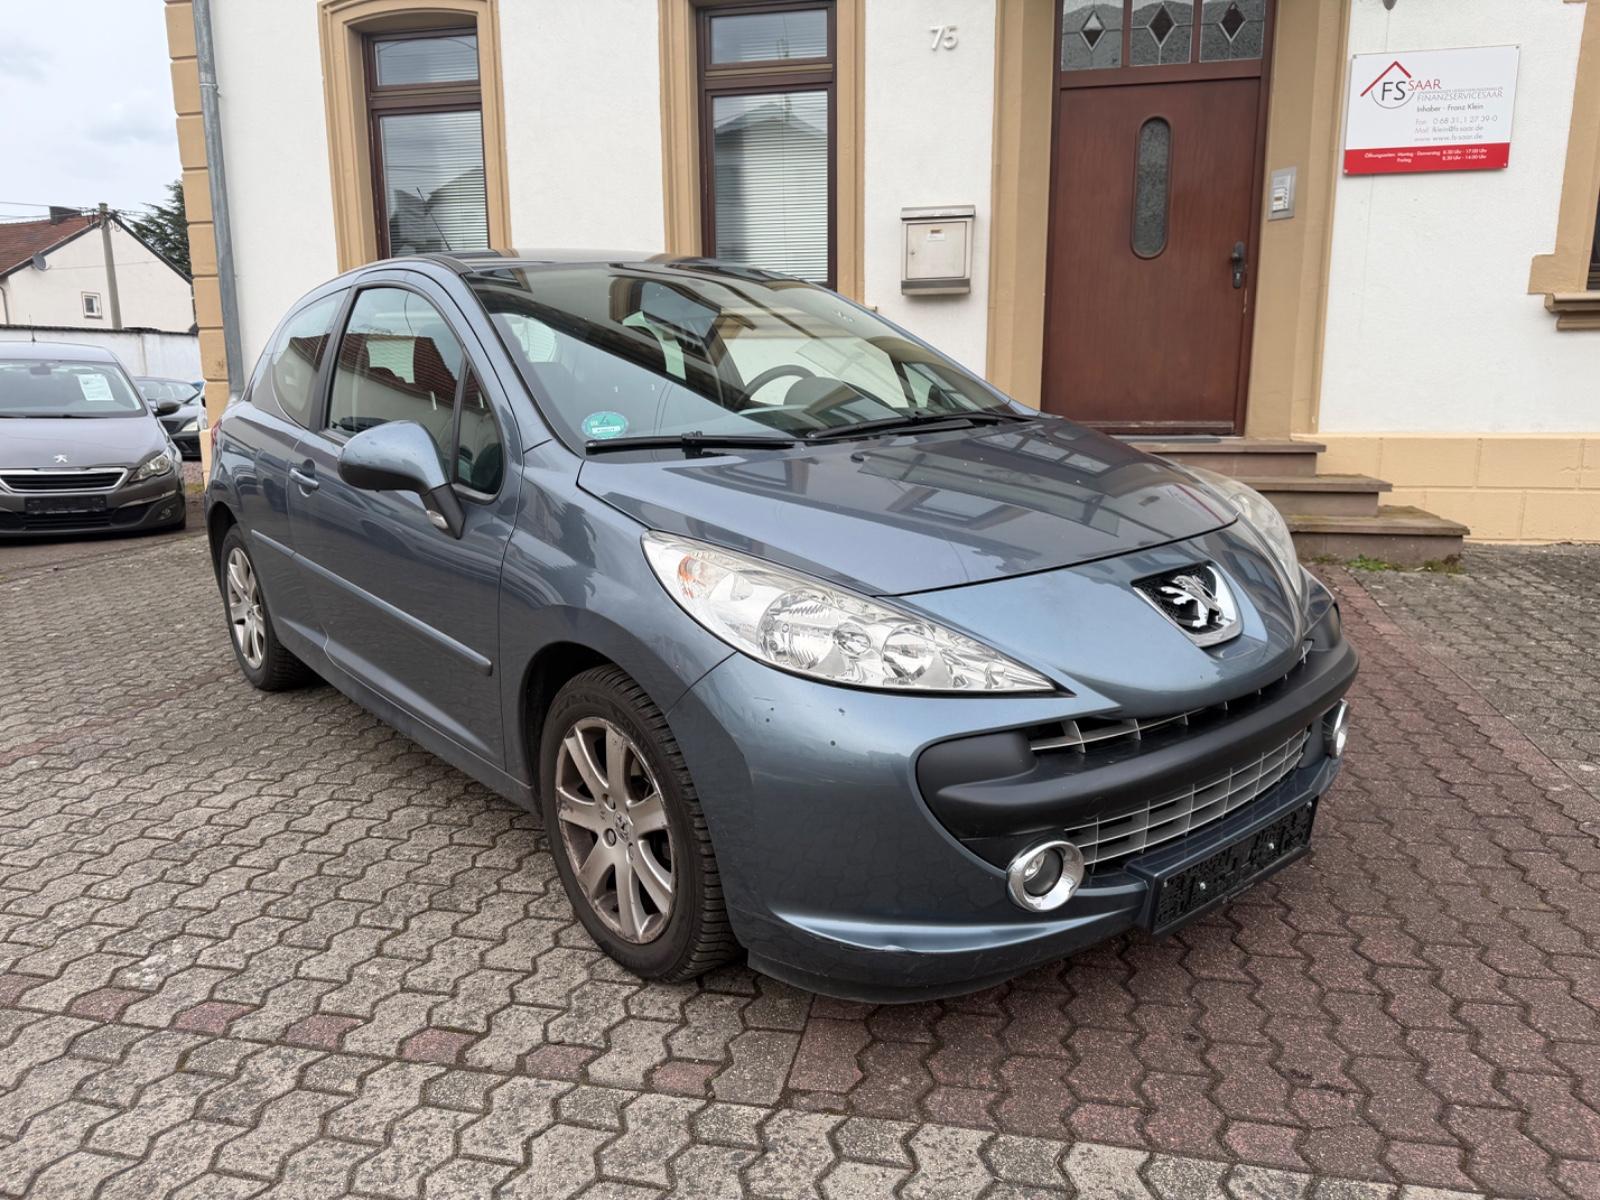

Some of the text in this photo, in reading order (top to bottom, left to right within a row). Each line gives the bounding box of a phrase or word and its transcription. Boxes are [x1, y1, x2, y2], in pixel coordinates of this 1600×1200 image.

[930, 25, 958, 51] 75
[1381, 80, 1406, 101] FS
[1407, 78, 1441, 91] SAAR
[1416, 105, 1441, 113] Inhaber
[1447, 103, 1466, 111] Franz
[1467, 102, 1484, 110] Klein
